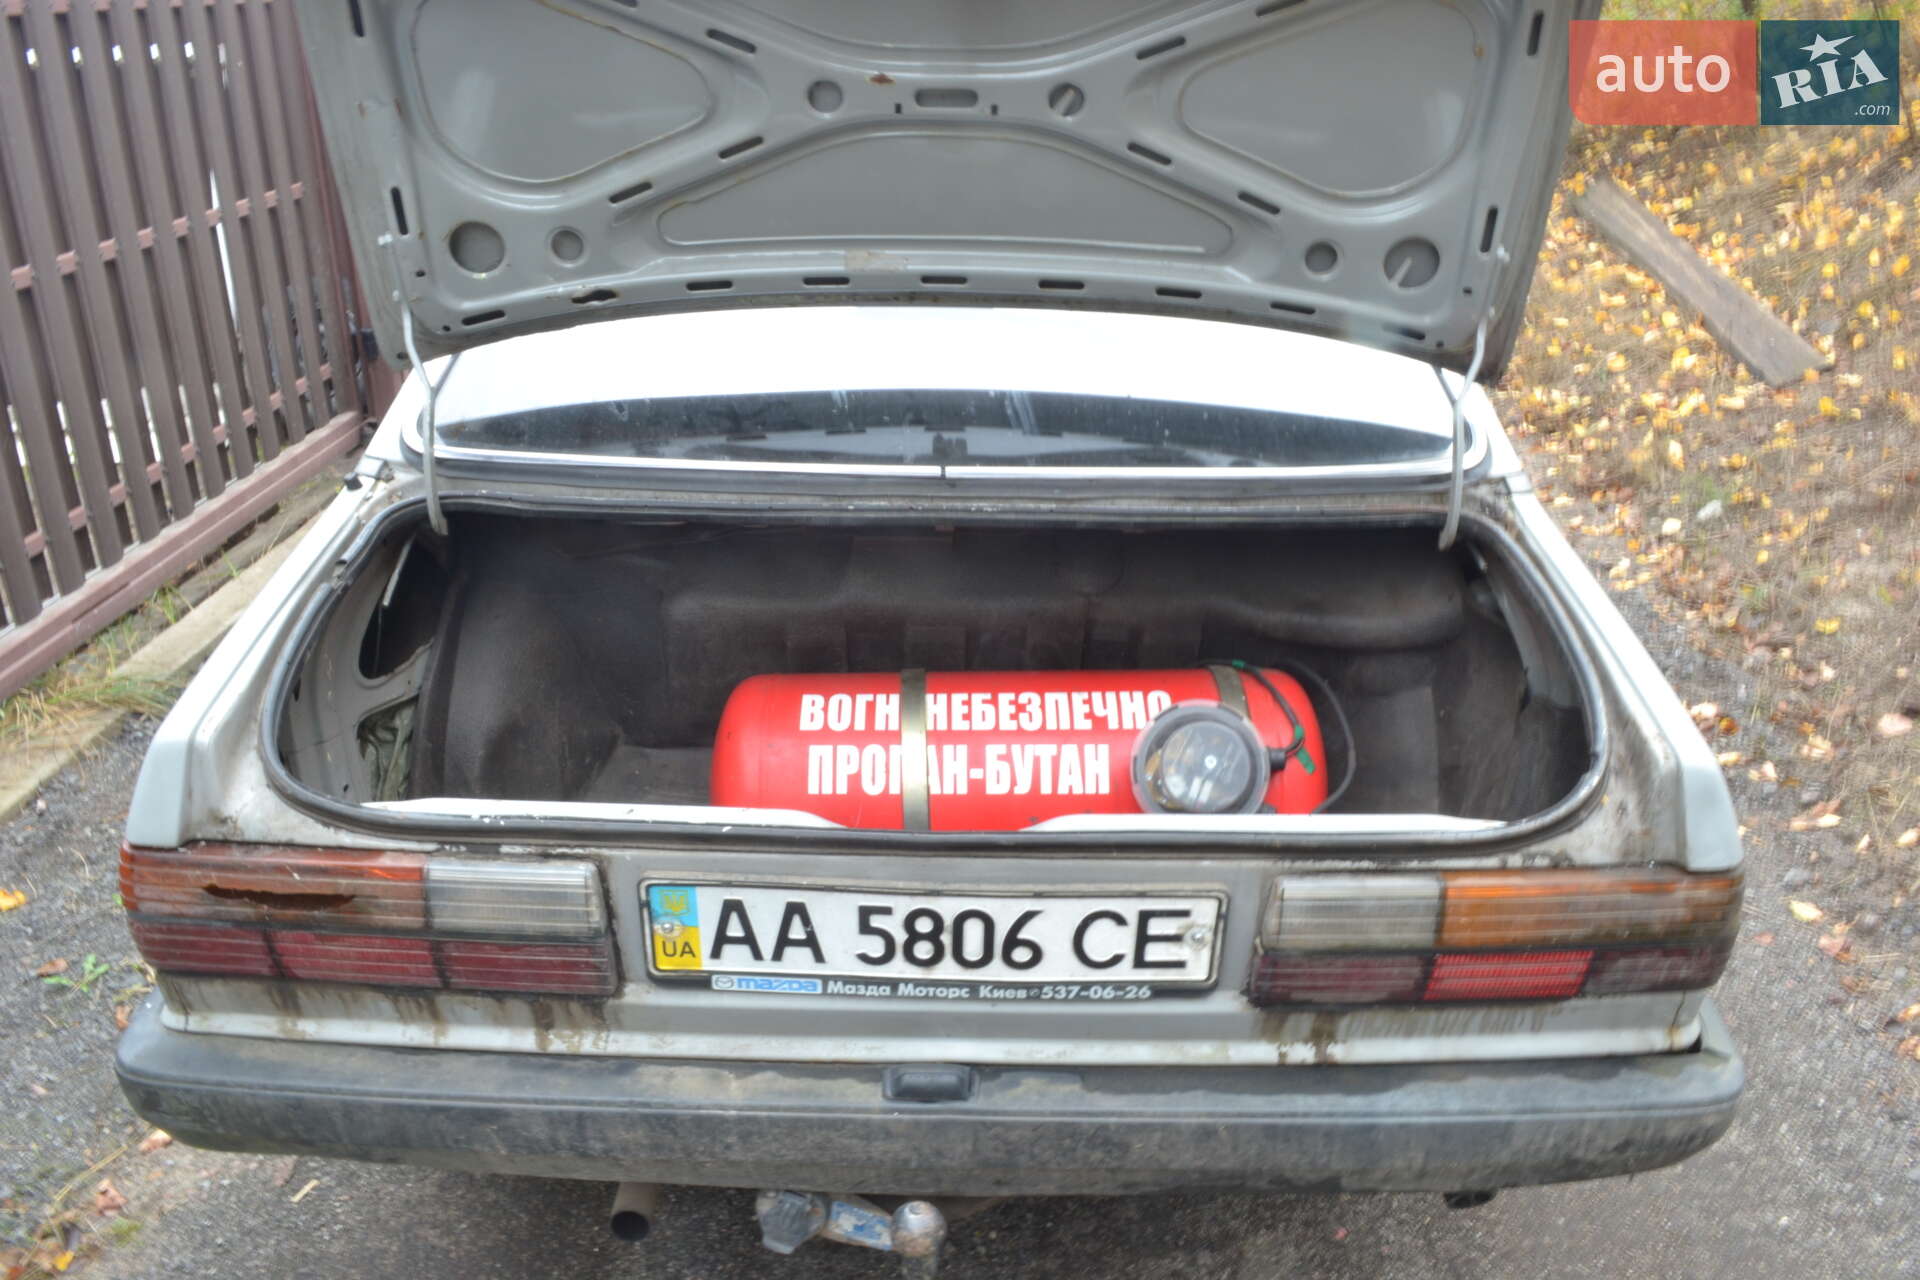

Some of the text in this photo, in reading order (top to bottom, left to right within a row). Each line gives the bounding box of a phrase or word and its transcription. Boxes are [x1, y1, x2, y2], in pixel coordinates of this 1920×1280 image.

[799, 686, 1172, 732] ВОГННЕБЕЗПЕЧНО
[661, 939, 697, 958] UA
[709, 897, 1192, 970] AA 5806 CE
[826, 980, 1152, 1000] Мазда Моторс Киев 537-06-26
